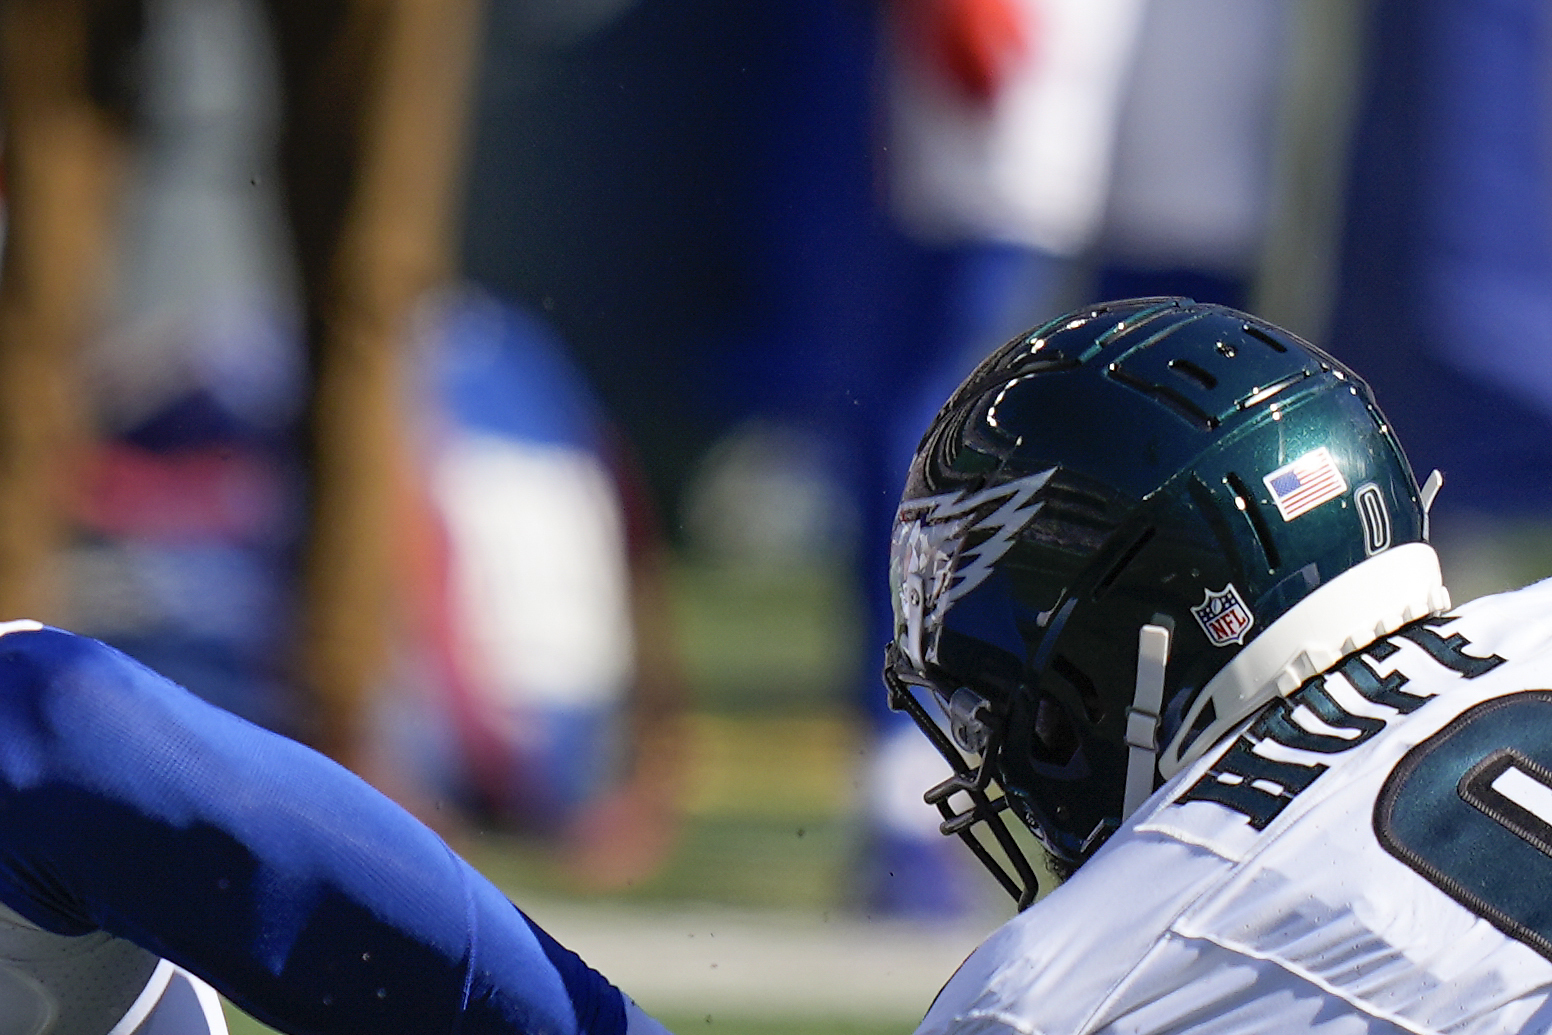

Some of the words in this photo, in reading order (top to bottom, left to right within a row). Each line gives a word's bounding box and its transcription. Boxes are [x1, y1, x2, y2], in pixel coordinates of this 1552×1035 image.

[1353, 480, 1393, 557] 0
[1209, 608, 1248, 641] NFL
[1173, 614, 1509, 833] HUFF
